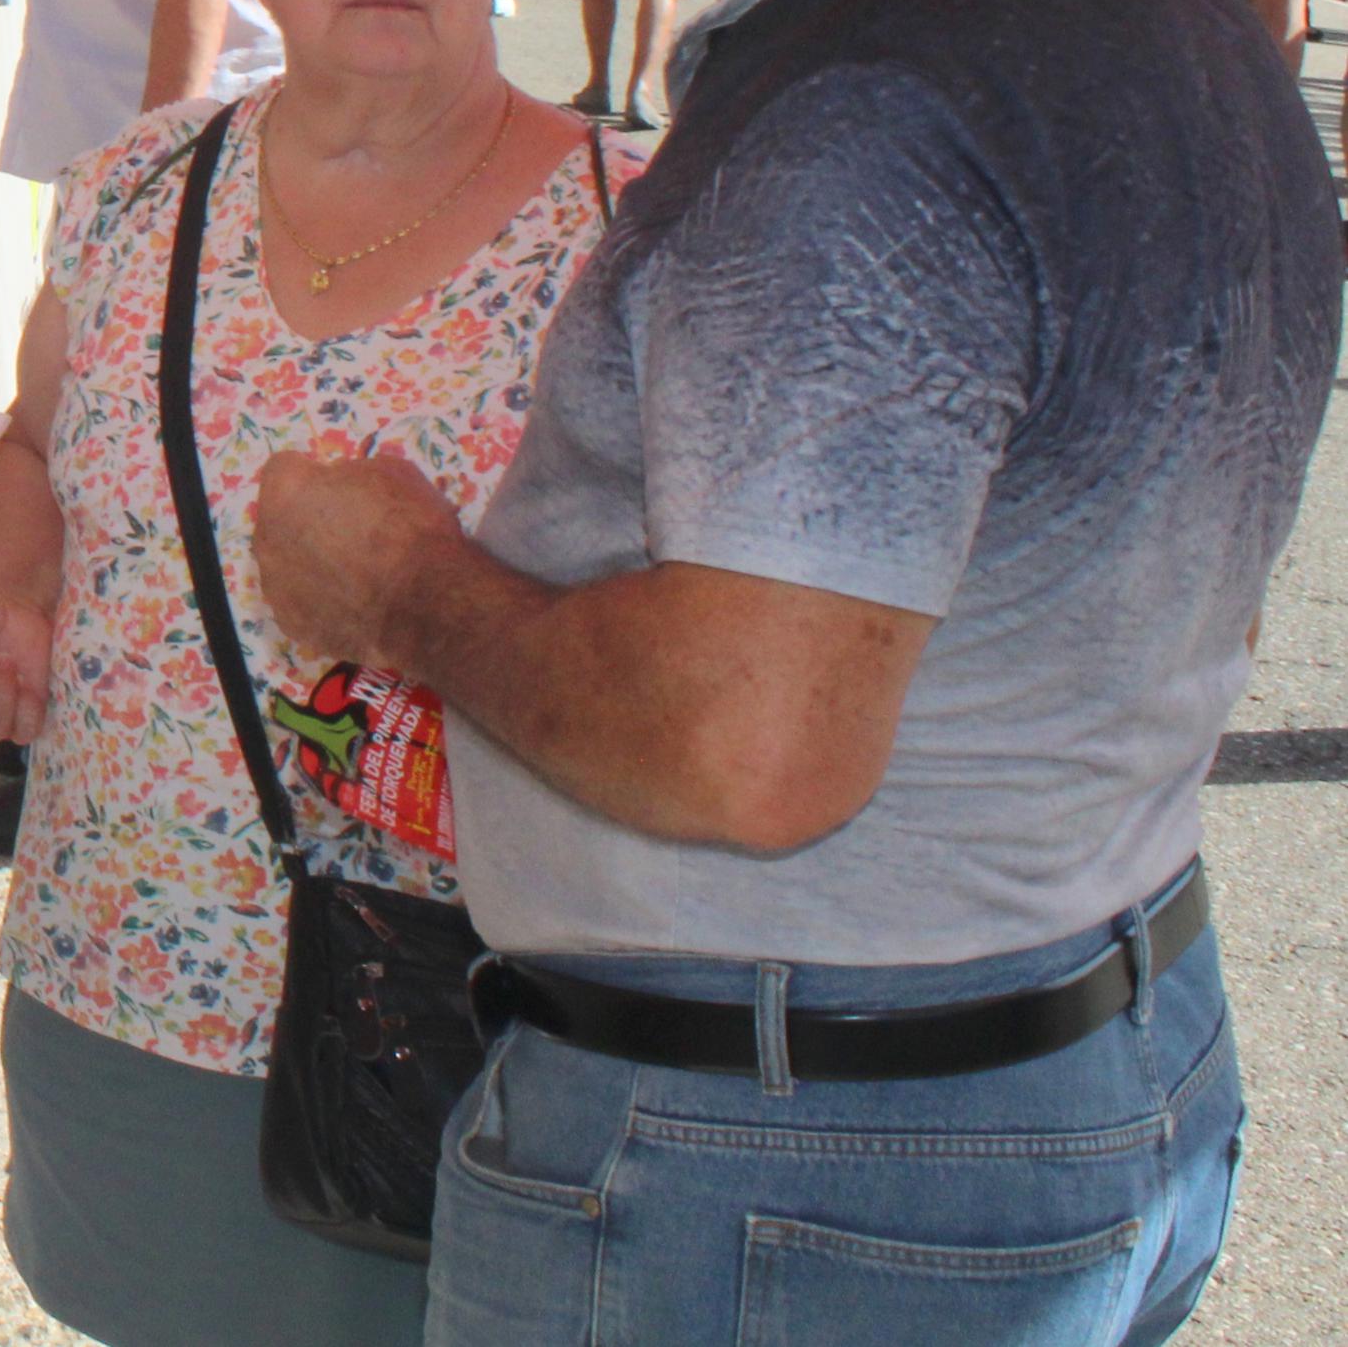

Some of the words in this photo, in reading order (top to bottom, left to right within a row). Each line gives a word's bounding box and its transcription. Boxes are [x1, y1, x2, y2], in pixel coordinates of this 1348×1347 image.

[364, 746, 384, 779] DEL
[380, 704, 425, 803] TORQUEMADA
[359, 773, 381, 819] FERIA
[380, 802, 397, 828] DE
